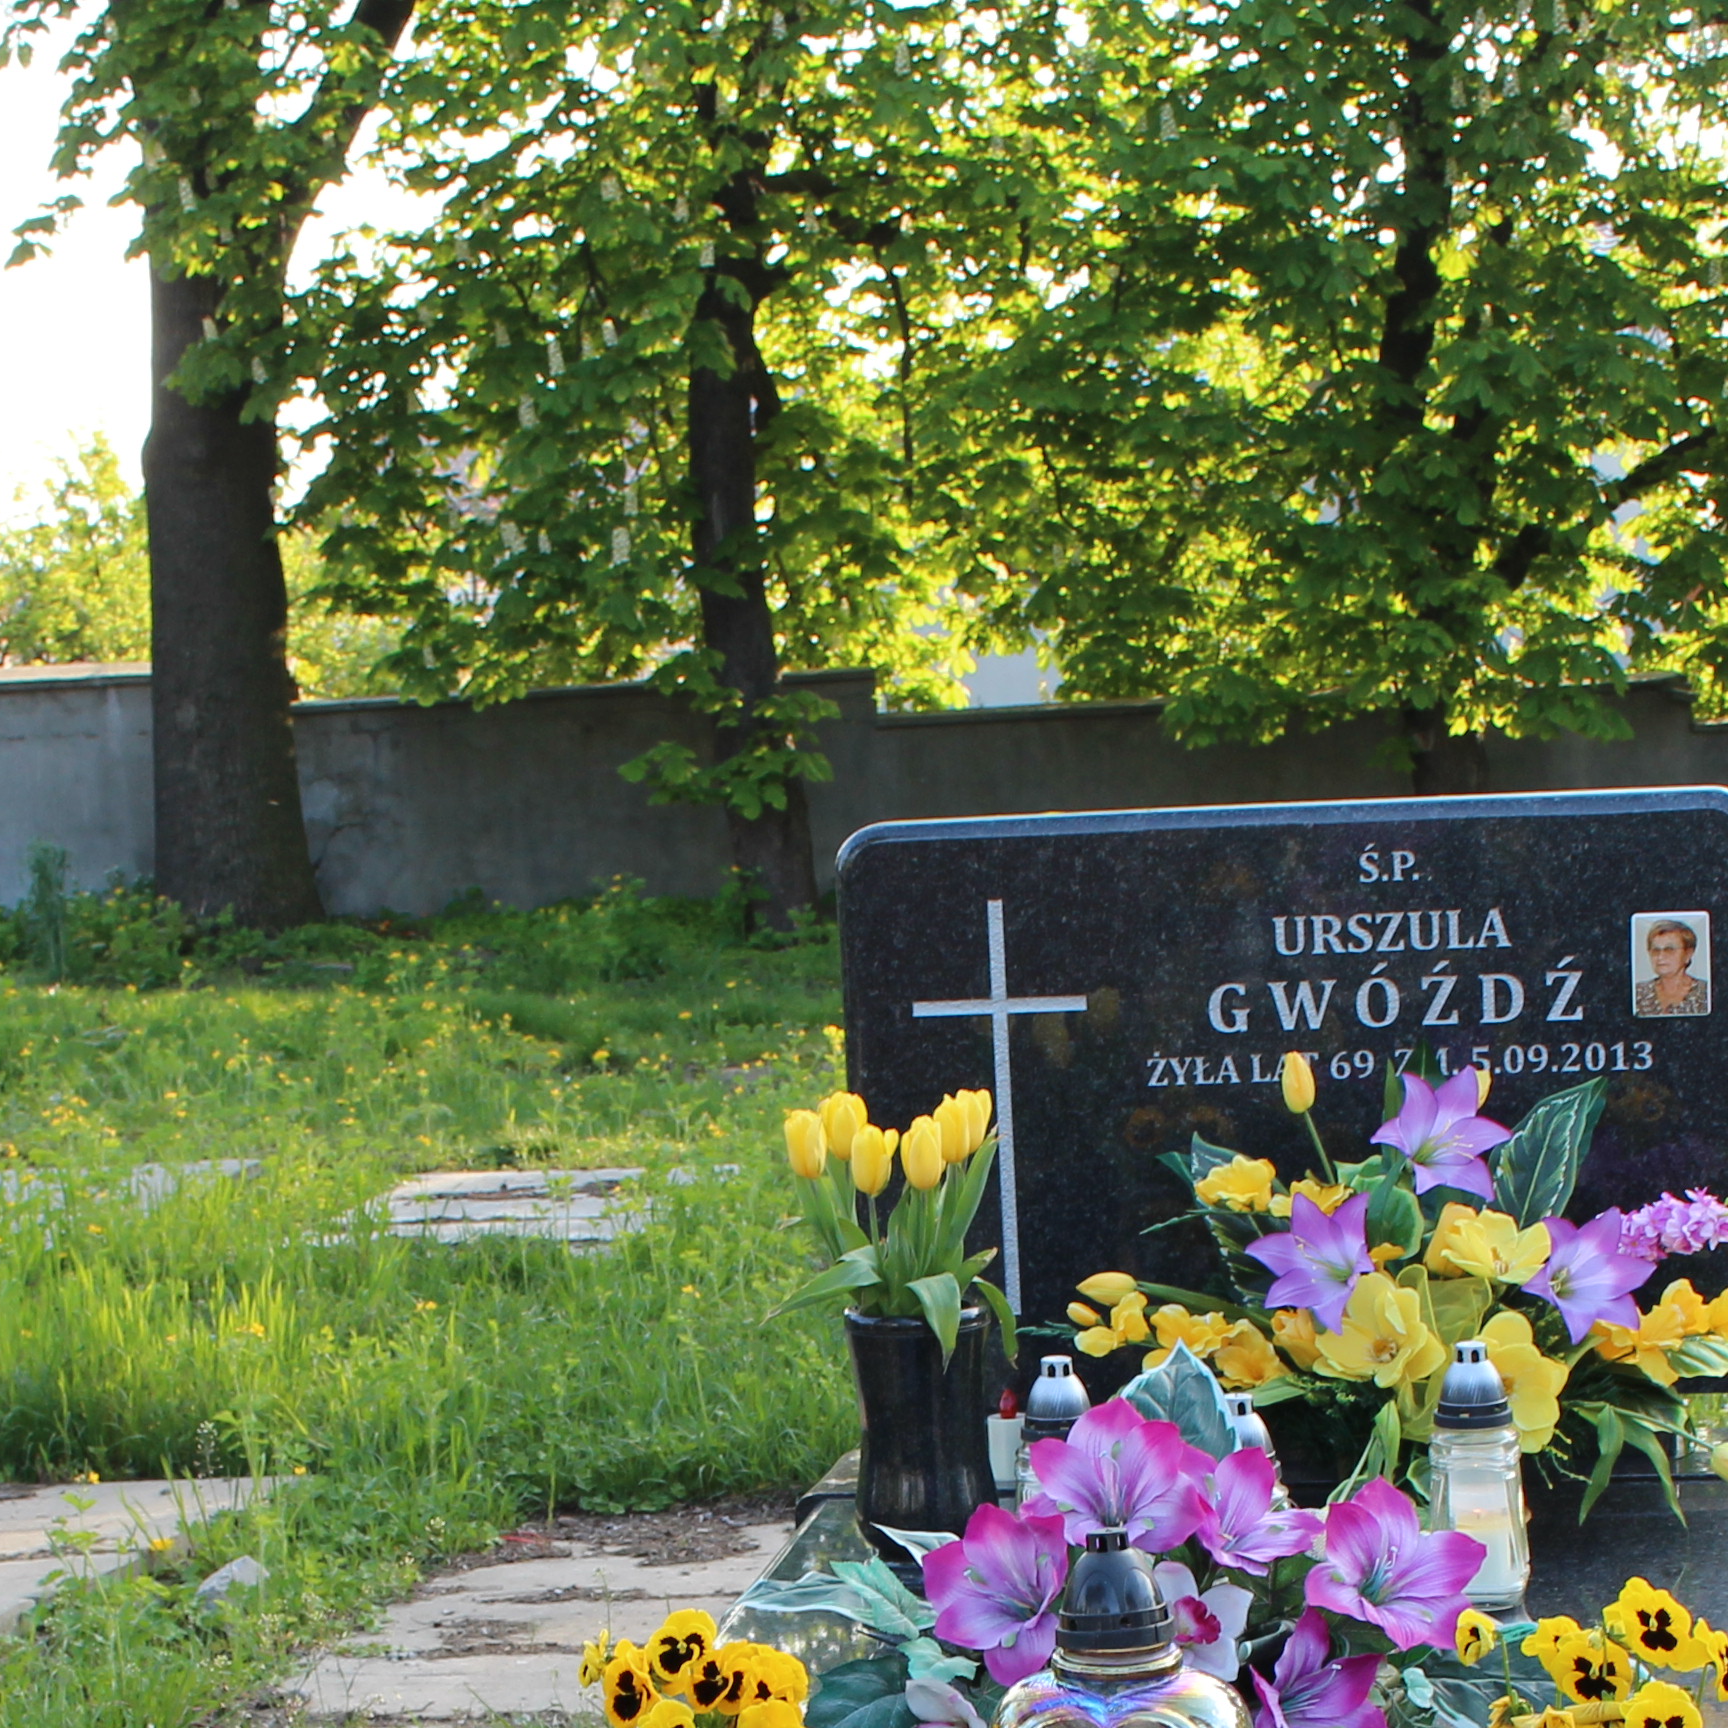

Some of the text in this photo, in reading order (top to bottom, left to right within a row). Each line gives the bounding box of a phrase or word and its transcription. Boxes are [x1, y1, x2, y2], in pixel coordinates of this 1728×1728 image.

[1358, 843, 1421, 884] Ś.P.
[1271, 906, 1513, 957] URSZULA
[1206, 955, 1585, 1034] GWÓŹDŹ
[1146, 1050, 1242, 1088] ŻYŁA
[1329, 1048, 1376, 1081] 69
[1472, 1041, 1656, 1074] 5.09.2013
